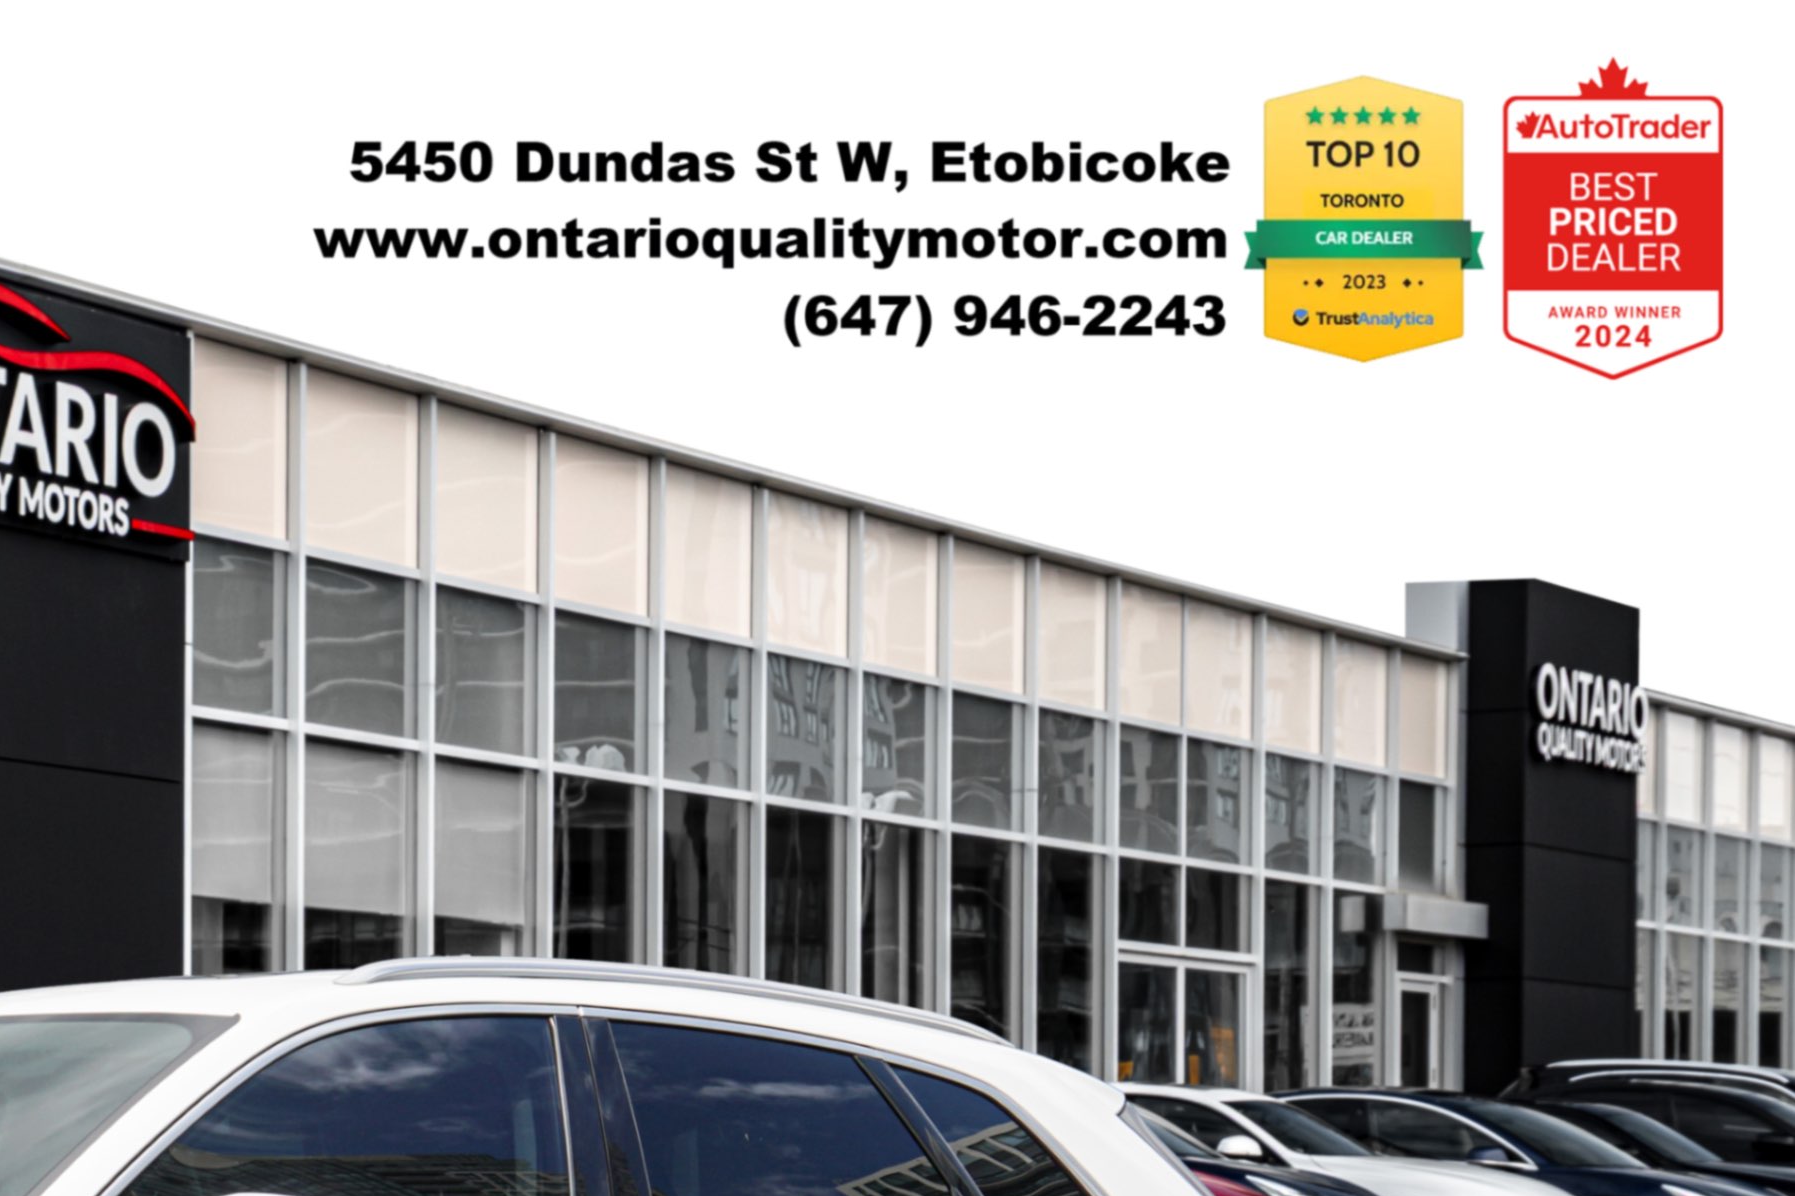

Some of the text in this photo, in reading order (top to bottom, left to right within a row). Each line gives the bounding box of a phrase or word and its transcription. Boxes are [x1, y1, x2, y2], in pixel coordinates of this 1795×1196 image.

[18, 476, 130, 537] MOTORS
[1536, 661, 1649, 739] ONTARIO
[1537, 721, 1595, 763] QUALITY
